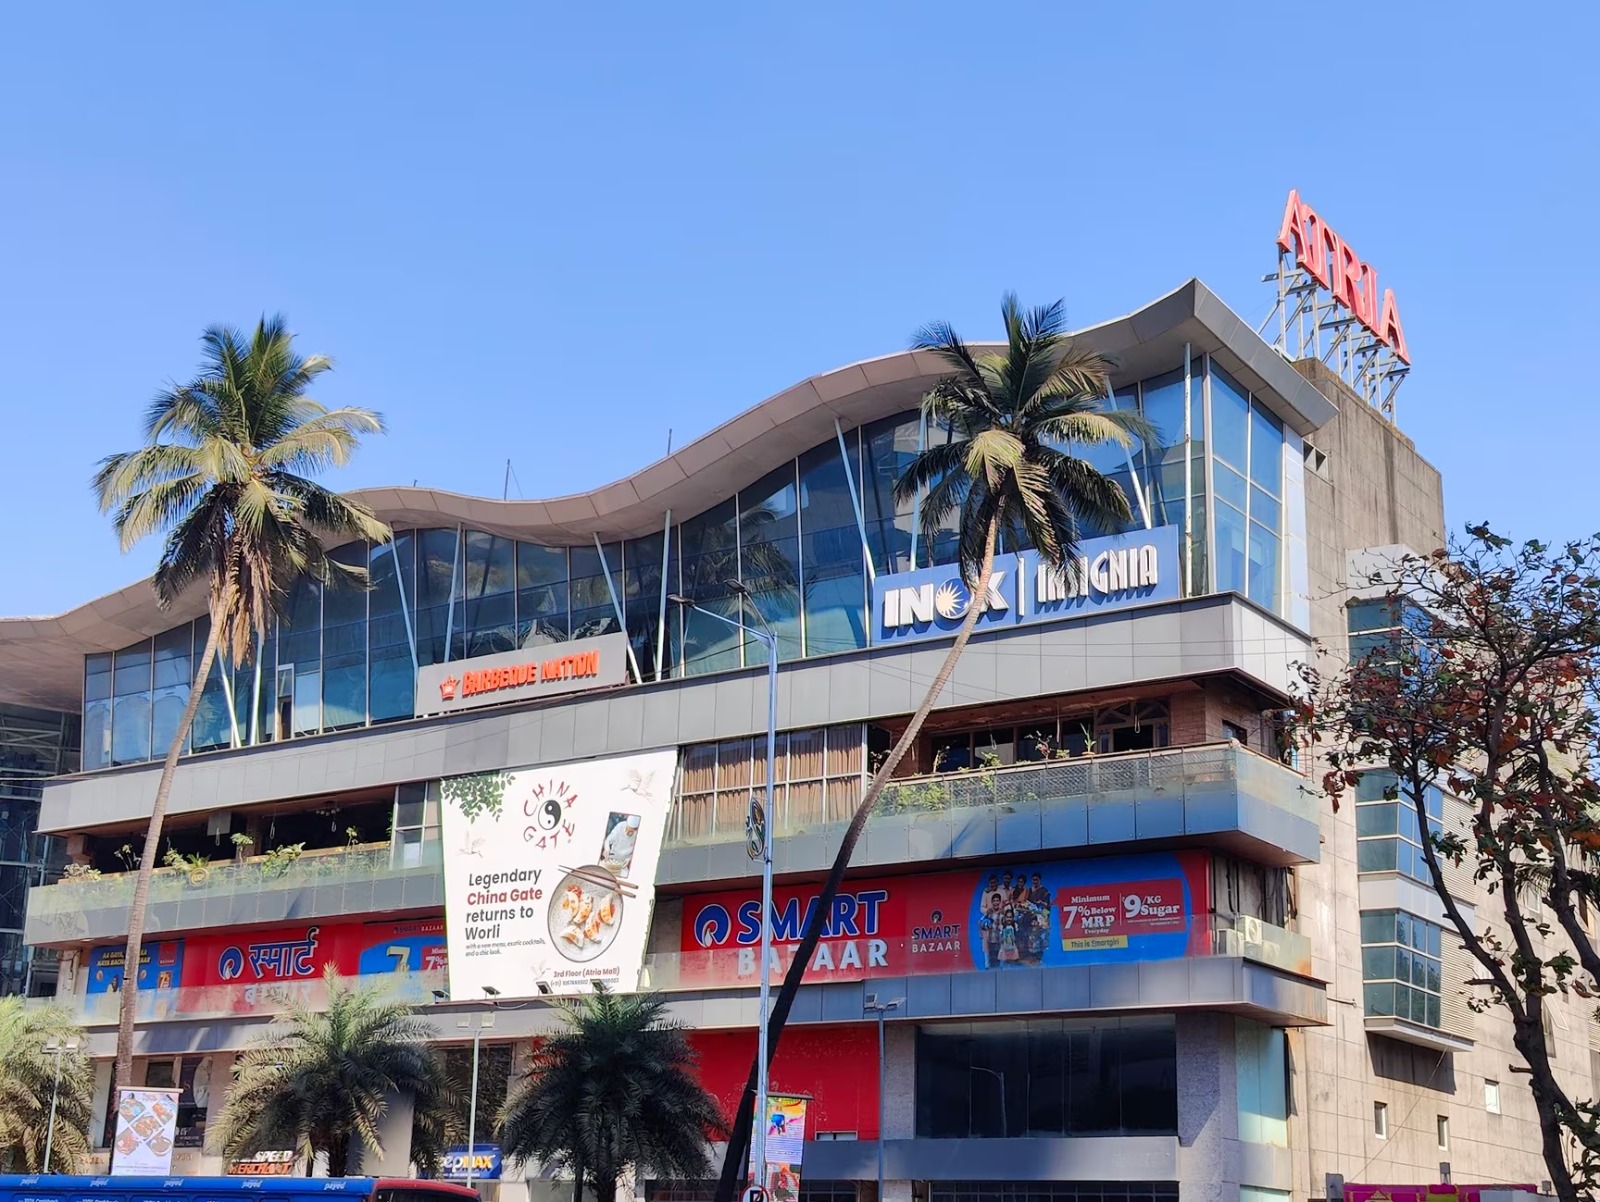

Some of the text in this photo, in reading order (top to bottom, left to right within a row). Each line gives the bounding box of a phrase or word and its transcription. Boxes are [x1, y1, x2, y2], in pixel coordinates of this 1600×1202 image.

[1276, 189, 1411, 365] ATRIA
[884, 570, 1009, 628] INOX
[462, 650, 600, 697] BARBEQUE NATION
[523, 779, 578, 817] CHINA
[523, 819, 575, 853] GATE
[468, 868, 542, 890] Legendary
[467, 887, 543, 906] China Gate
[1071, 894, 1111, 904] Minimum
[466, 905, 534, 923] returns to
[737, 890, 888, 945] SMART
[1140, 904, 1180, 917] Sugar
[465, 923, 500, 941] Worli
[911, 924, 961, 940] SMART
[1081, 915, 1115, 929] MRP
[248, 926, 320, 979] स्मार्ट
[912, 941, 961, 953] BAZAAR
[738, 939, 889, 976] BAAAR
[254, 1150, 293, 1162] SPEED
